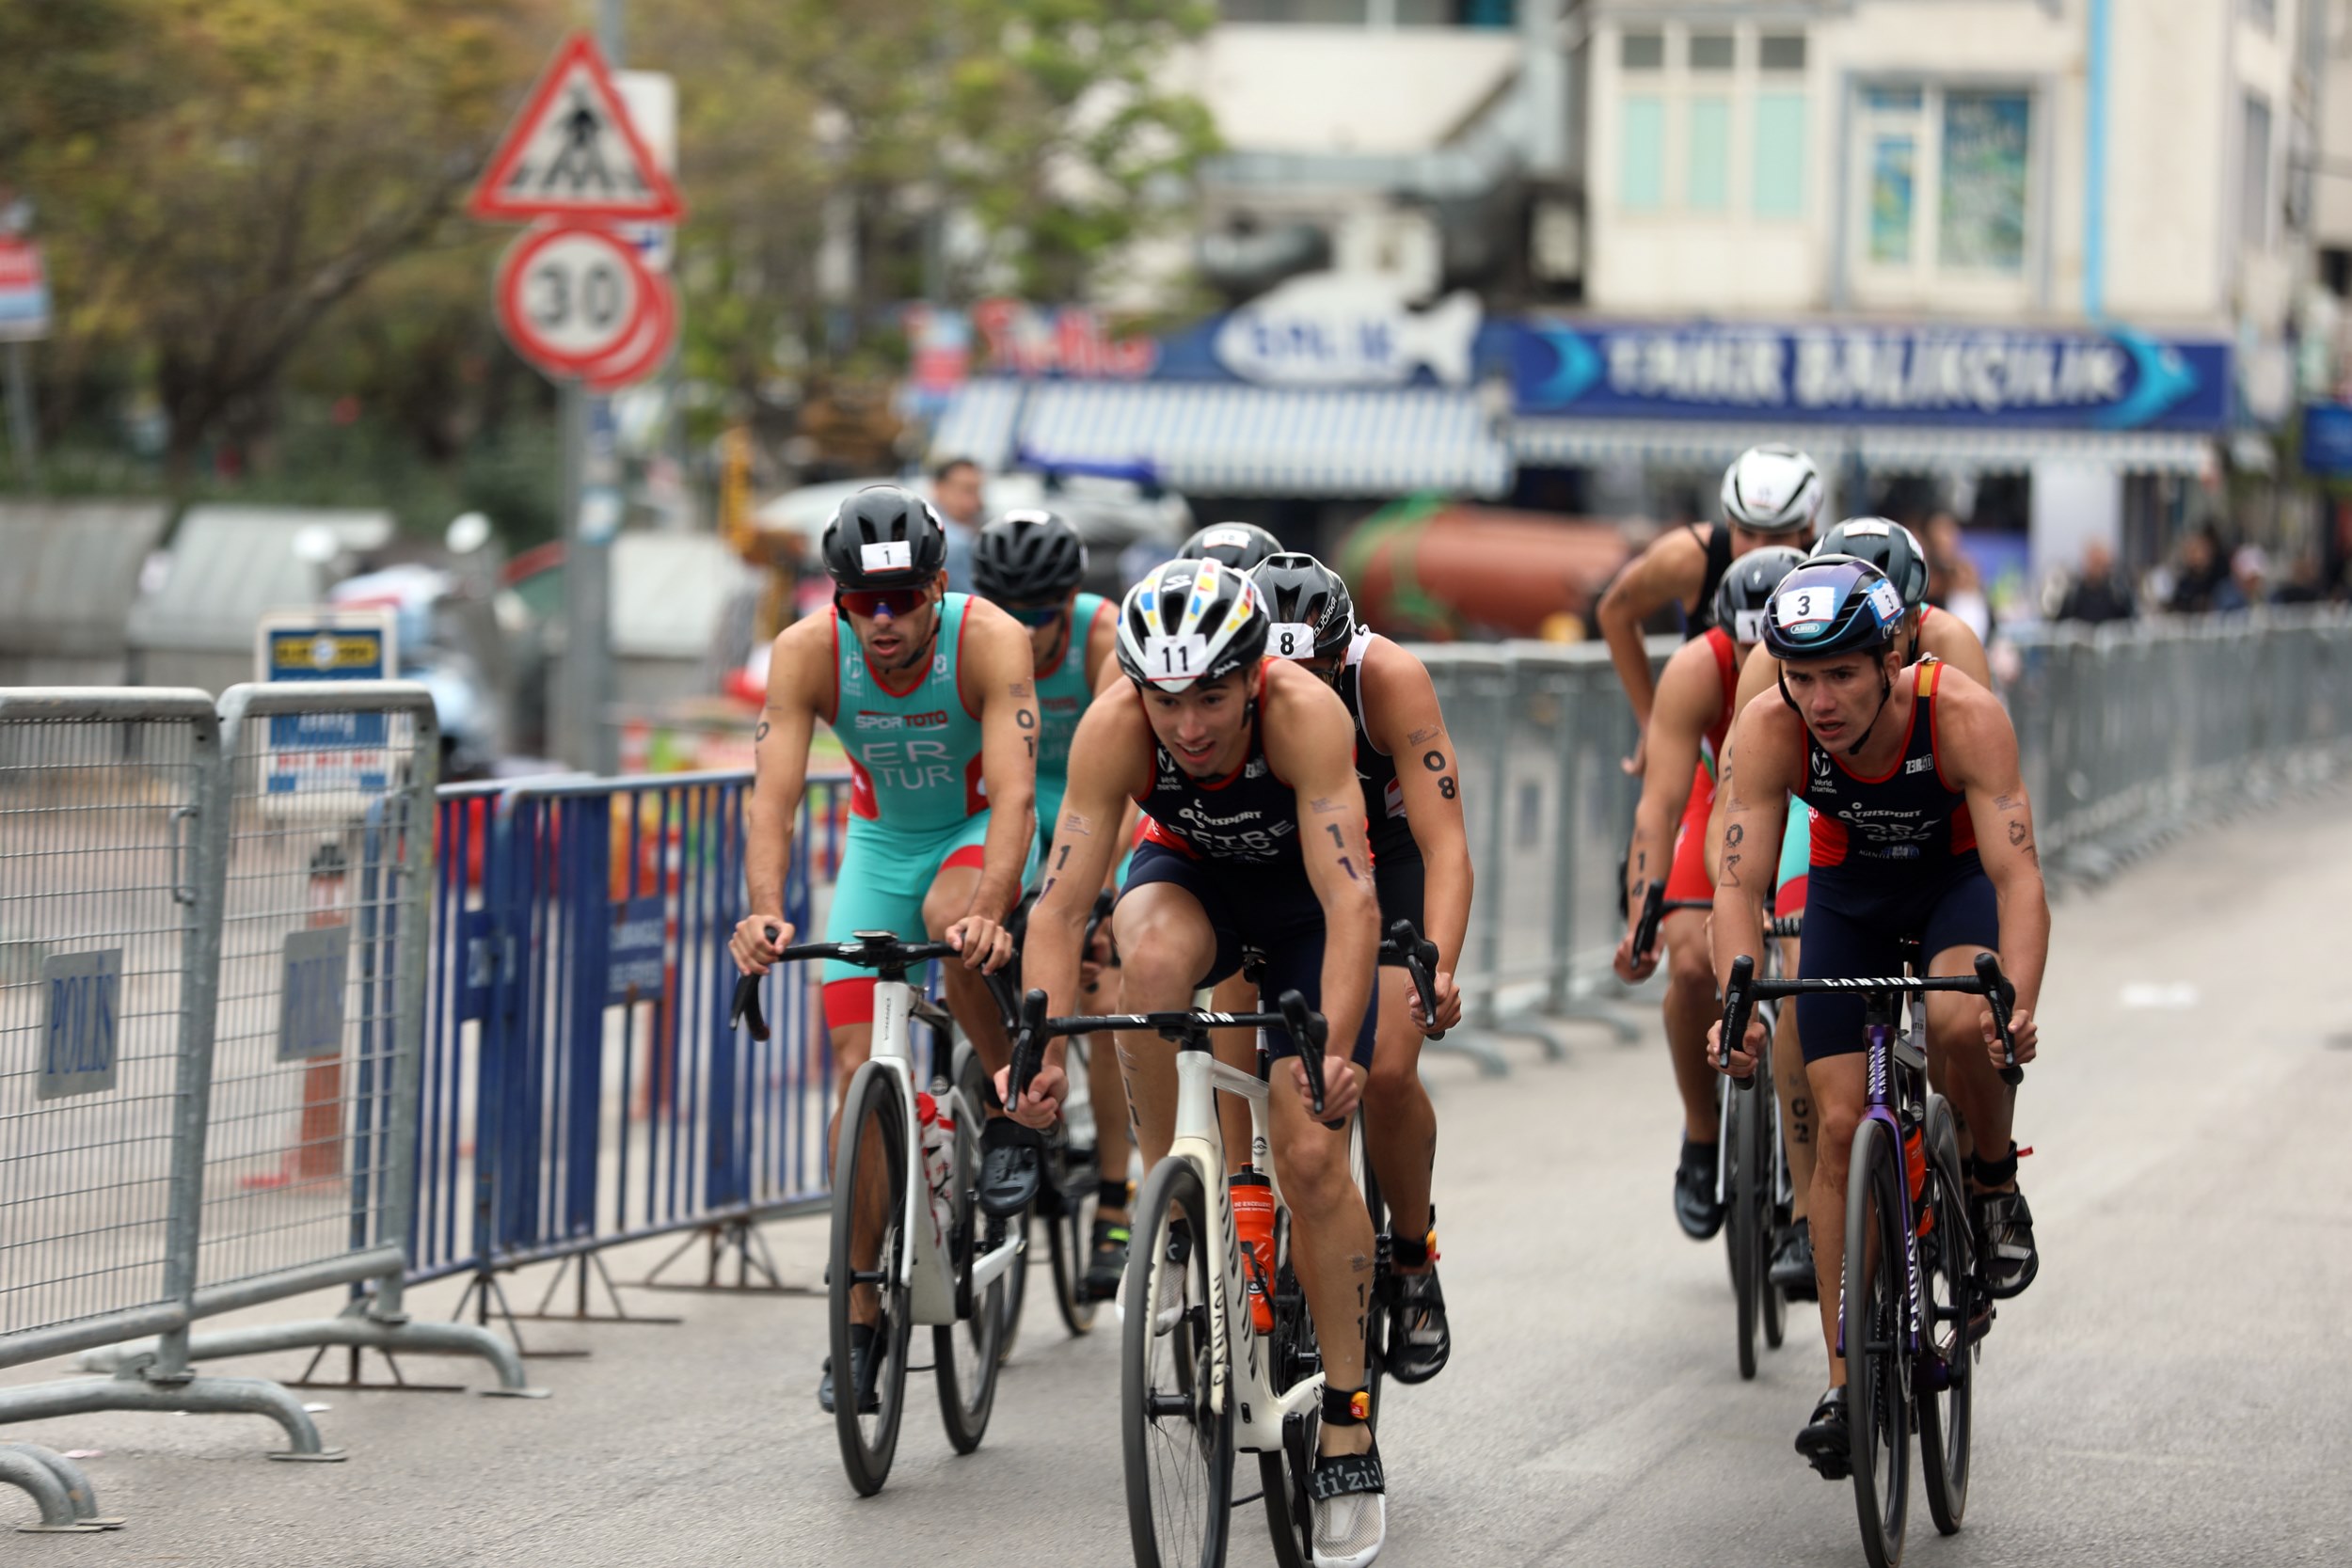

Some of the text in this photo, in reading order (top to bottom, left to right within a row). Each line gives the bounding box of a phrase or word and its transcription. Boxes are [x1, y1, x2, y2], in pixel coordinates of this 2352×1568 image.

[536, 261, 623, 330] 30
[883, 549, 891, 565] 1
[1797, 595, 1811, 616] 3
[1884, 594, 1894, 610] 3
[1314, 596, 1338, 638] BJÖRKA
[1792, 625, 1818, 633] ABUS
[1279, 632, 1295, 656] 8
[1162, 645, 1189, 673] 11
[863, 740, 956, 765] ER
[874, 765, 956, 789] TUR
[1815, 779, 1833, 787] World
[1811, 785, 1837, 795] Triathlon
[1854, 809, 1923, 818] TRISPORT
[1821, 977, 1923, 987] CANYON
[1867, 1046, 1876, 1096] CANYON
[1878, 1046, 1886, 1095] CANYON
